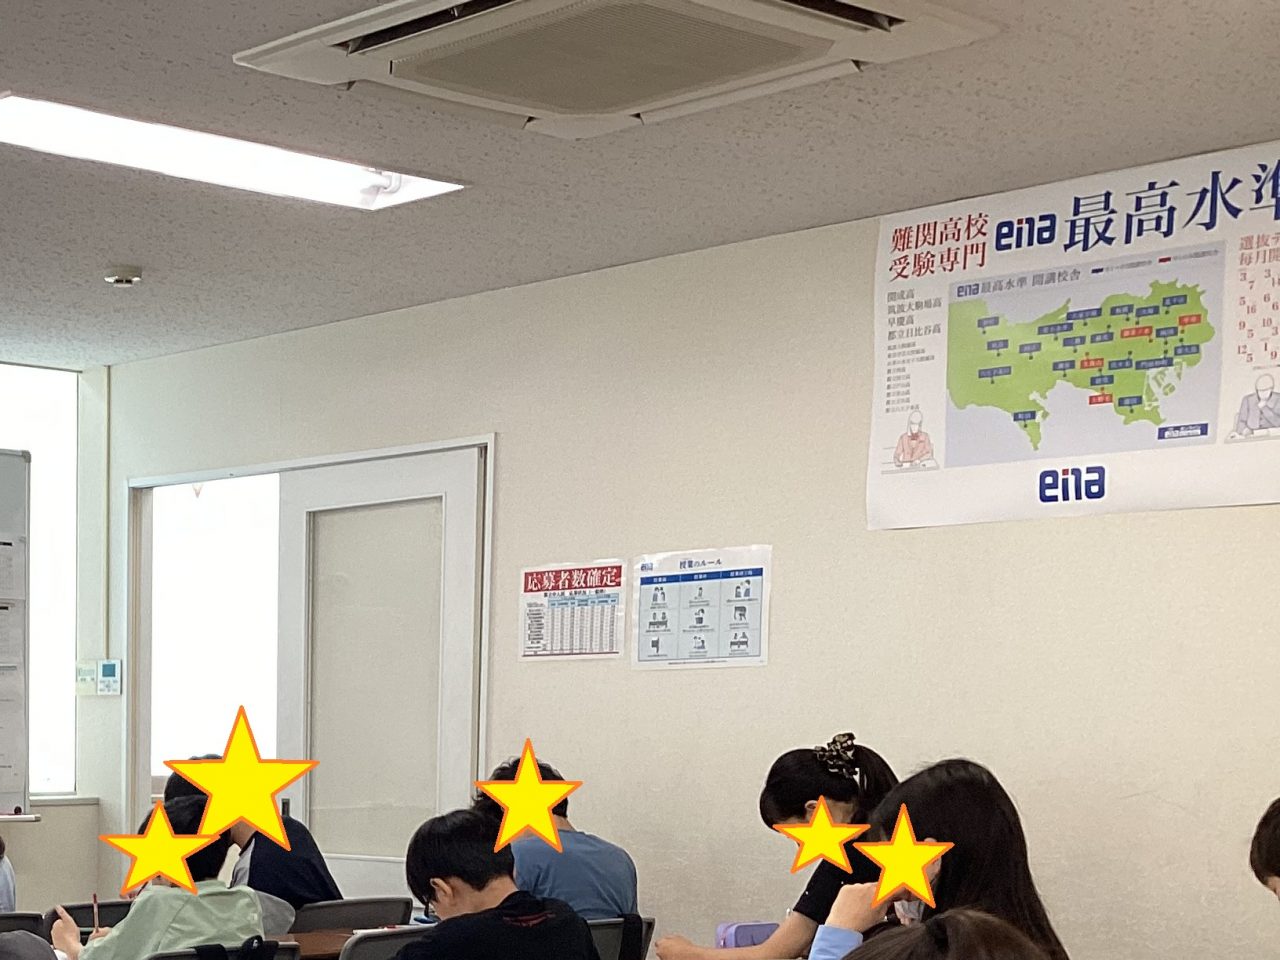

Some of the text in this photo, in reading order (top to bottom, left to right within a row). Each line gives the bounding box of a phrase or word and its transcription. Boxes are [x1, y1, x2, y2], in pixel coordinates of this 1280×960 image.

[890, 213, 989, 255] 難関高校
[889, 242, 987, 282] 受験専門
[888, 324, 941, 341] 都立日比谷高
[527, 567, 617, 591] 応募者数確定
